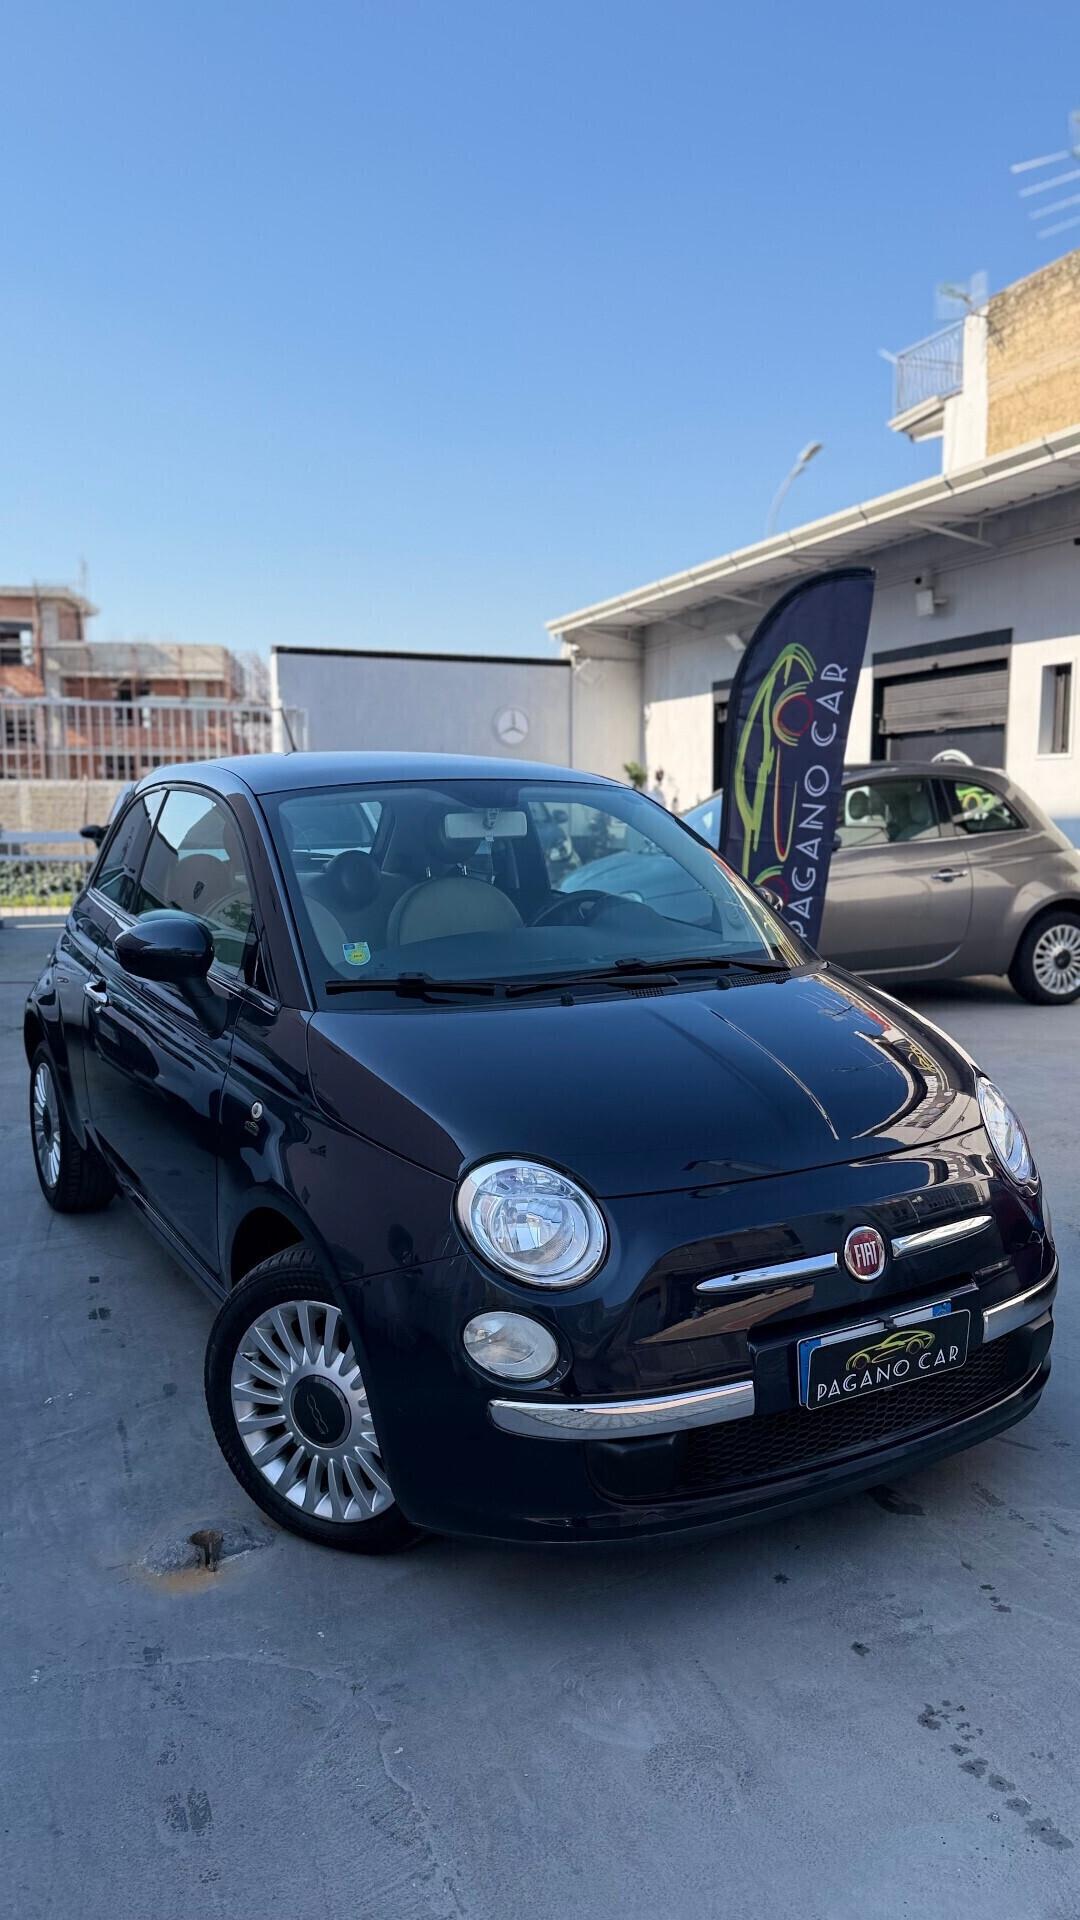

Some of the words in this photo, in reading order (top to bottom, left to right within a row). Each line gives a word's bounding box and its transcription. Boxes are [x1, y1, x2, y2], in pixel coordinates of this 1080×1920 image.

[811, 663, 848, 747] CAR
[853, 1240, 878, 1268] FIAT
[817, 1359, 910, 1401] PAGANO
[918, 1345, 959, 1370] CAR
